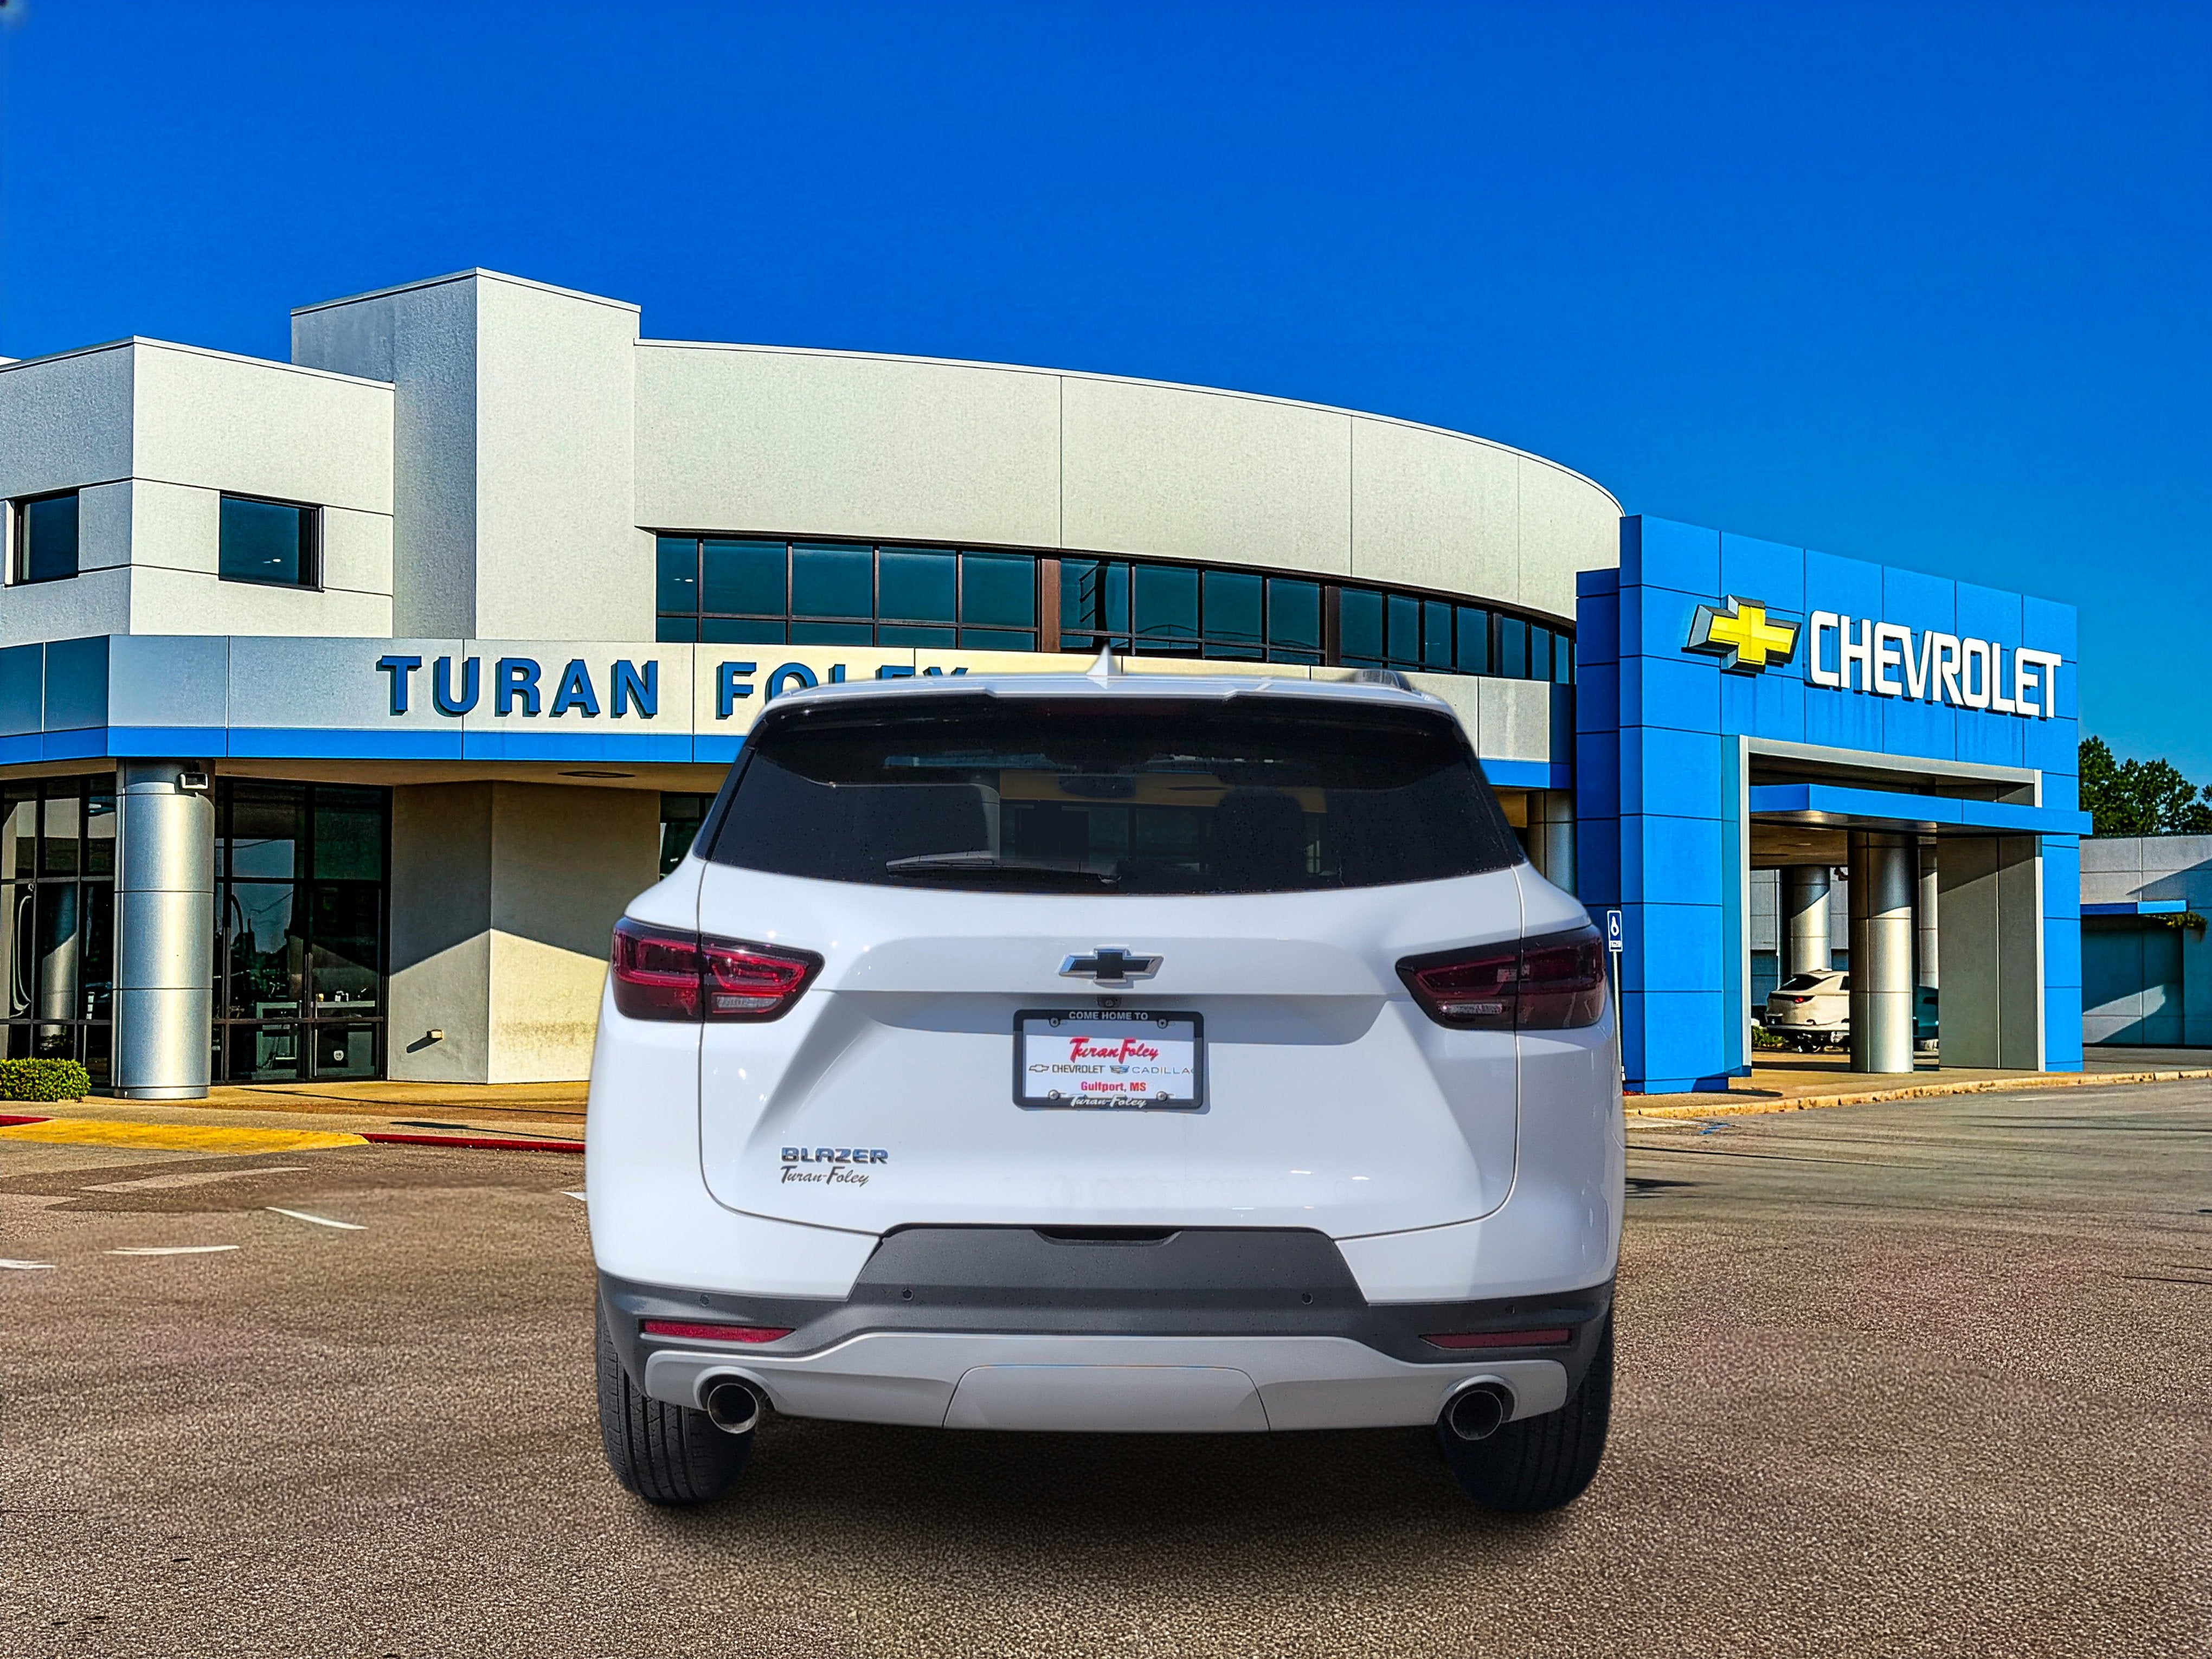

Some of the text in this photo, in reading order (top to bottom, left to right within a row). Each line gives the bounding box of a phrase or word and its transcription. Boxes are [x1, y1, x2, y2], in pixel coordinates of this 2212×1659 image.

[1810, 610, 2062, 719] CHEVROLET
[376, 655, 659, 719] TURAN
[1069, 1011, 1149, 1021] COME HOME TO
[1052, 1065, 1105, 1074] CHEVROLET
[1081, 1081, 1147, 1092] Gulfport, MS
[781, 1147, 889, 1164] BLAZER
